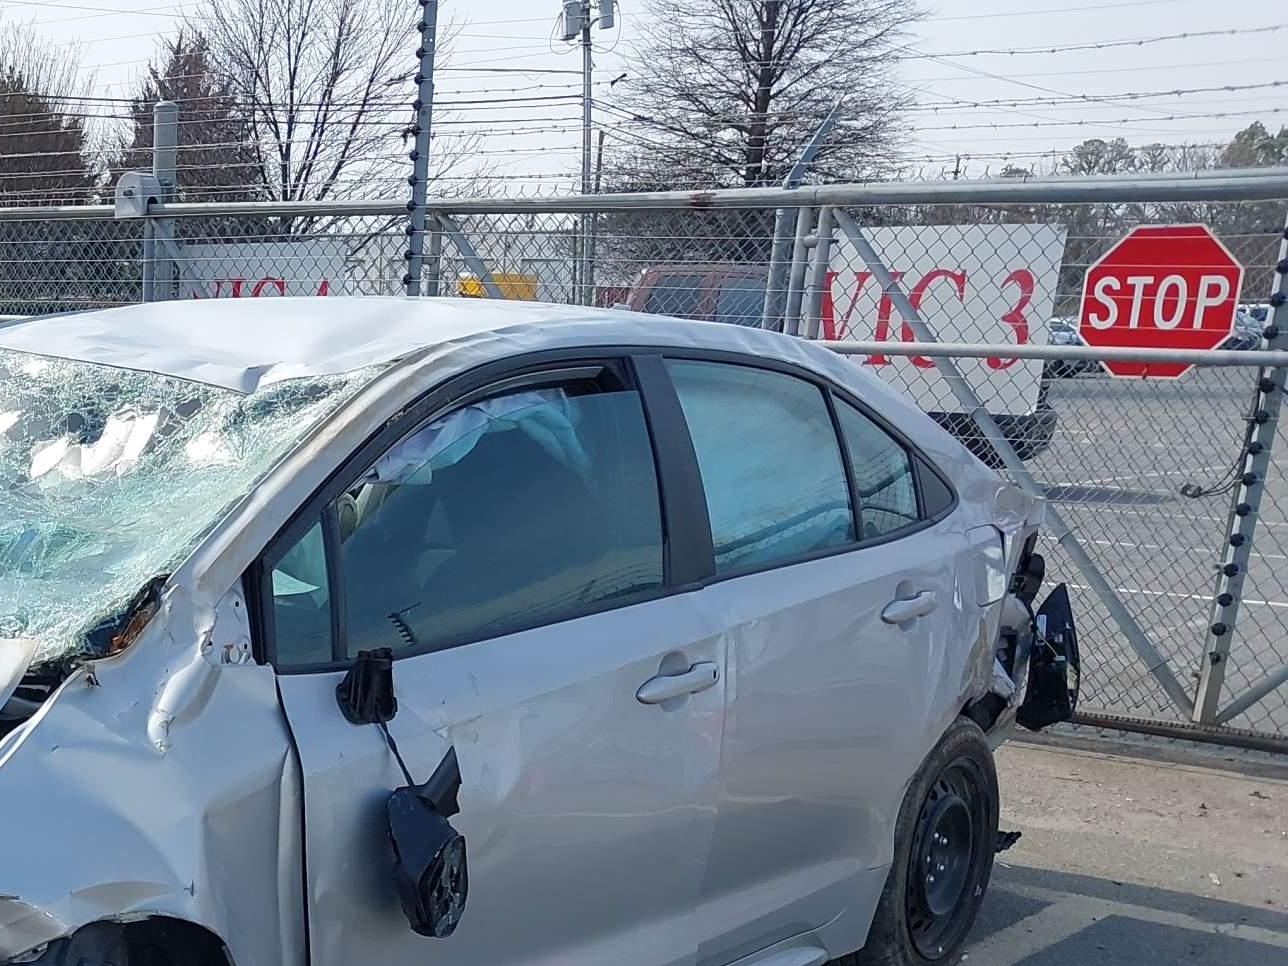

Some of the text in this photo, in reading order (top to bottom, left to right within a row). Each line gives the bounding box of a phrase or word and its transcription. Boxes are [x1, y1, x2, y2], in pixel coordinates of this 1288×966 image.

[821, 268, 1034, 370] VIC 3
[1088, 275, 1230, 330] STOP
